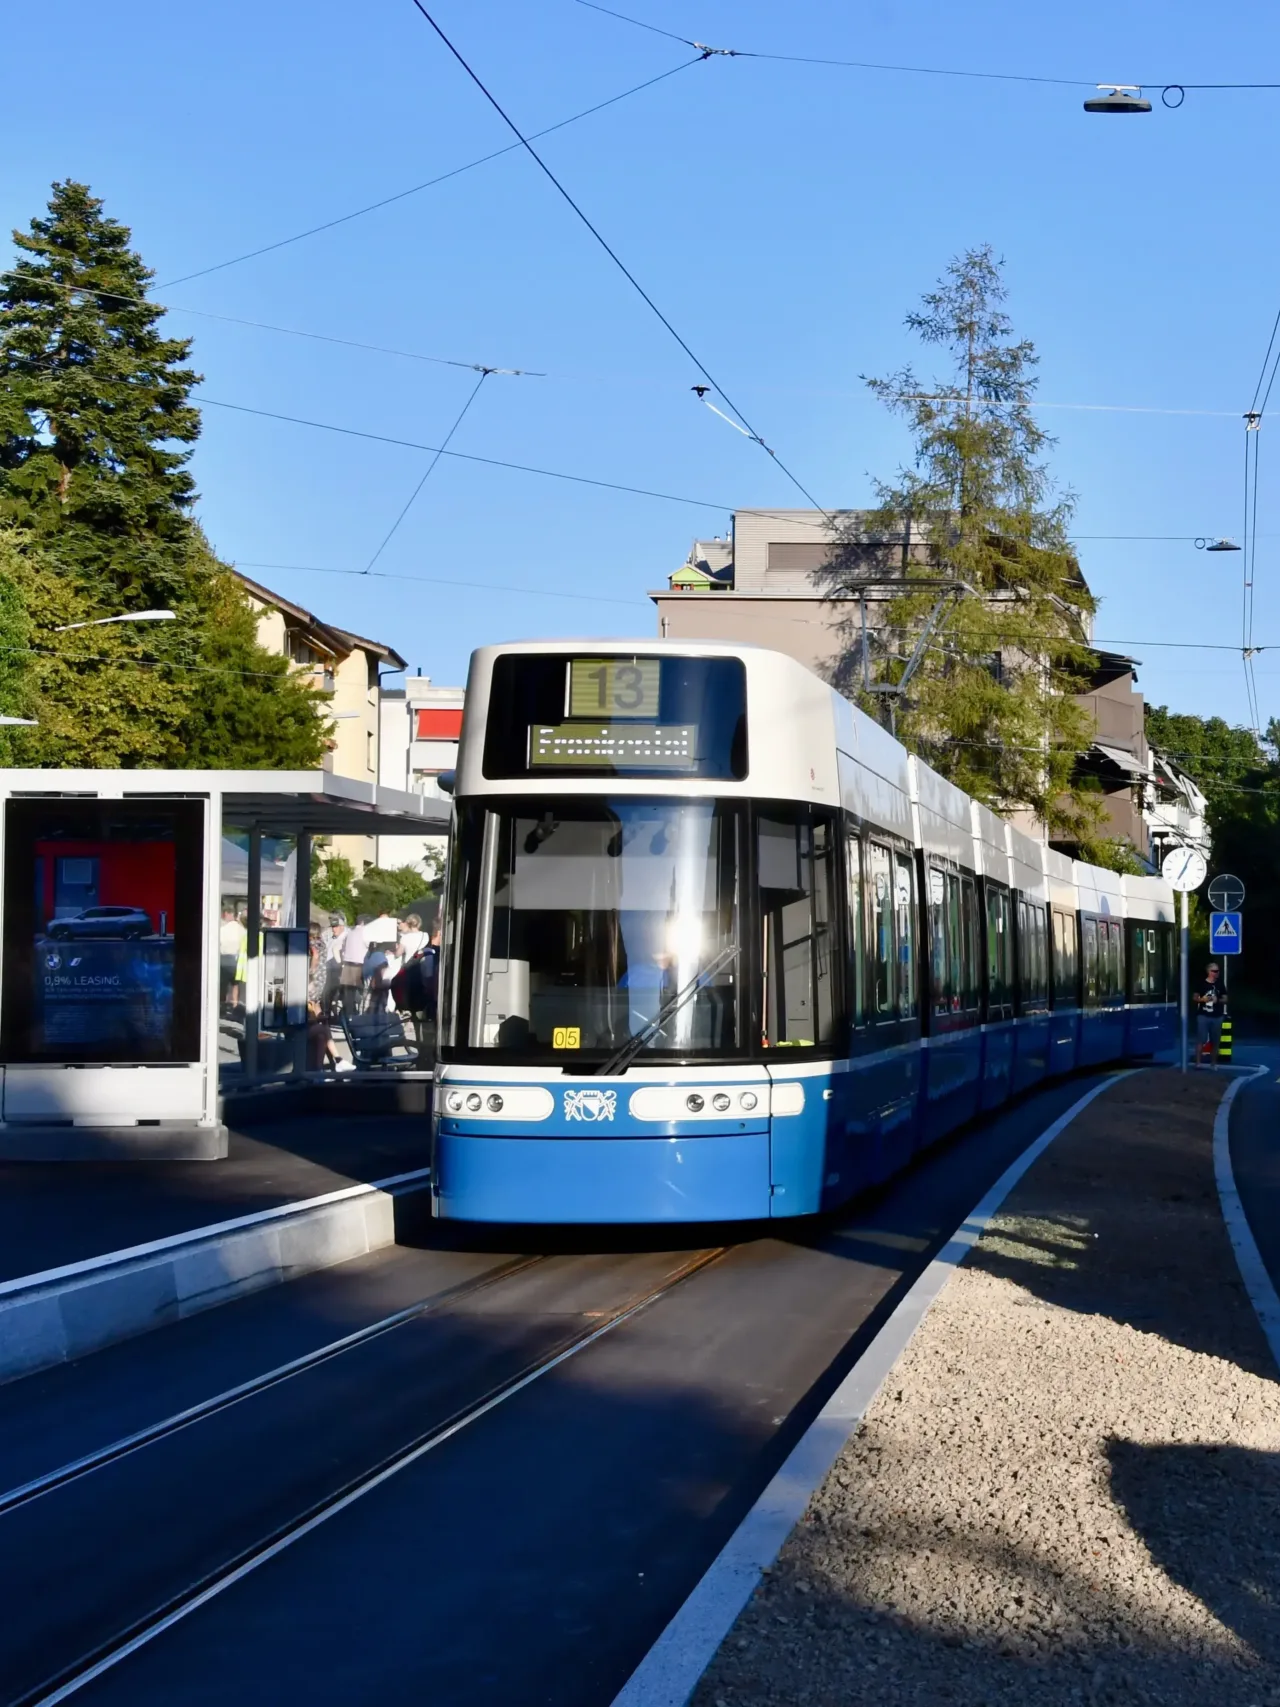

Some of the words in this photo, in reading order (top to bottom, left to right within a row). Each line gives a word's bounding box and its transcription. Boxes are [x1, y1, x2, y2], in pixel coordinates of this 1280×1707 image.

[588, 665, 644, 709] 13
[44, 976, 72, 987] 0,9%
[555, 1031, 577, 1046] 05
